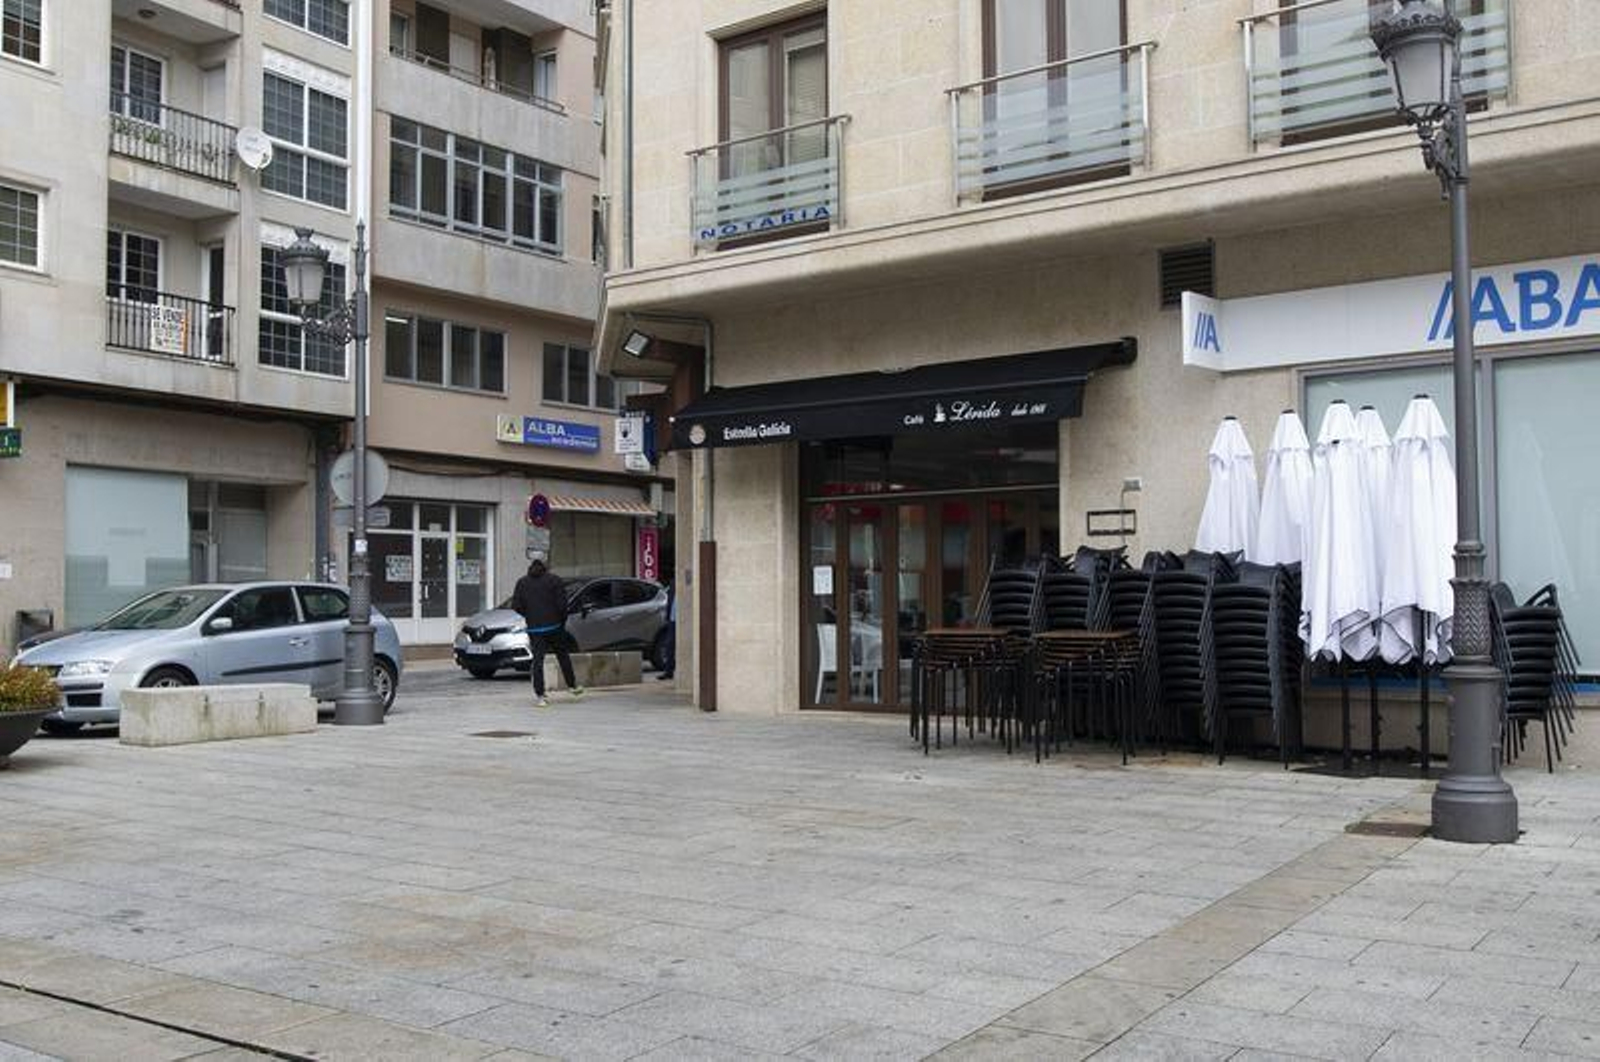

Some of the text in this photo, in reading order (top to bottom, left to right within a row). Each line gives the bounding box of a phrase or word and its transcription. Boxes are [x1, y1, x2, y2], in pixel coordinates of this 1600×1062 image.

[701, 206, 831, 239] NOTARIA
[527, 421, 566, 436] ALBA
[723, 422, 791, 440] Estrella Galicia
